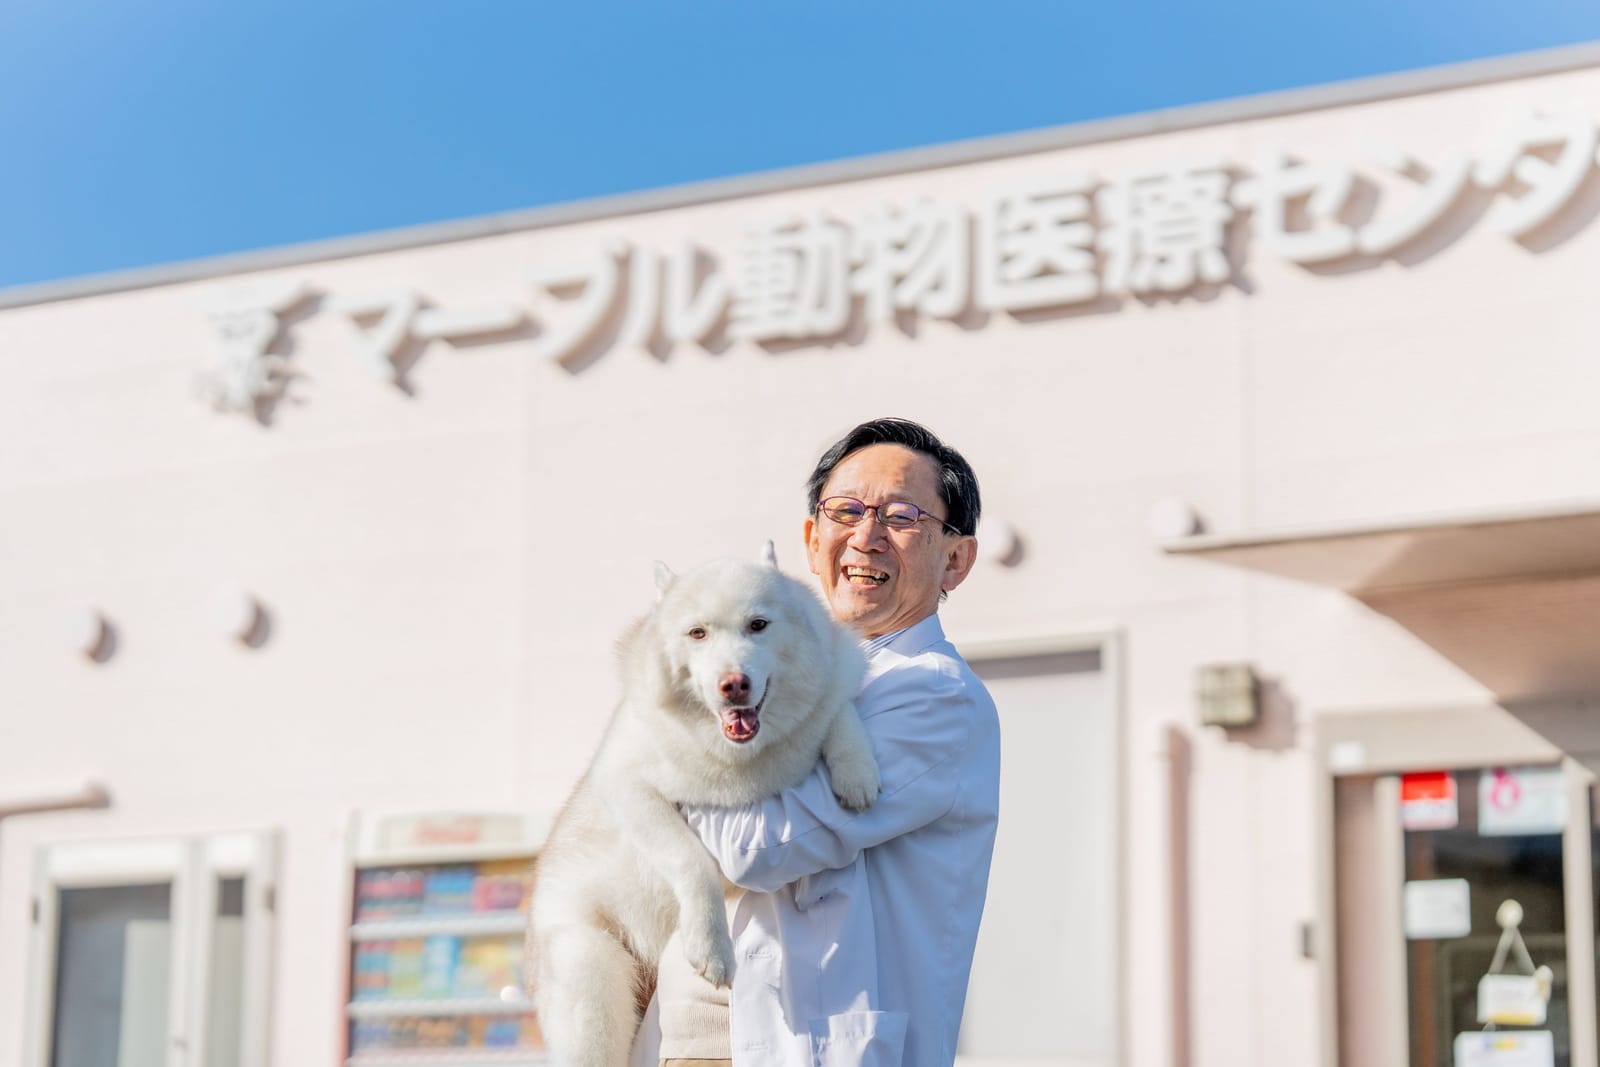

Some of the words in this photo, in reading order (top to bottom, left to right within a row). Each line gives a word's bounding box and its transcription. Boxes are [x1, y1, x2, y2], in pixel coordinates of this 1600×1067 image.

[320, 103, 1600, 385] マーブル動物医療センタ
